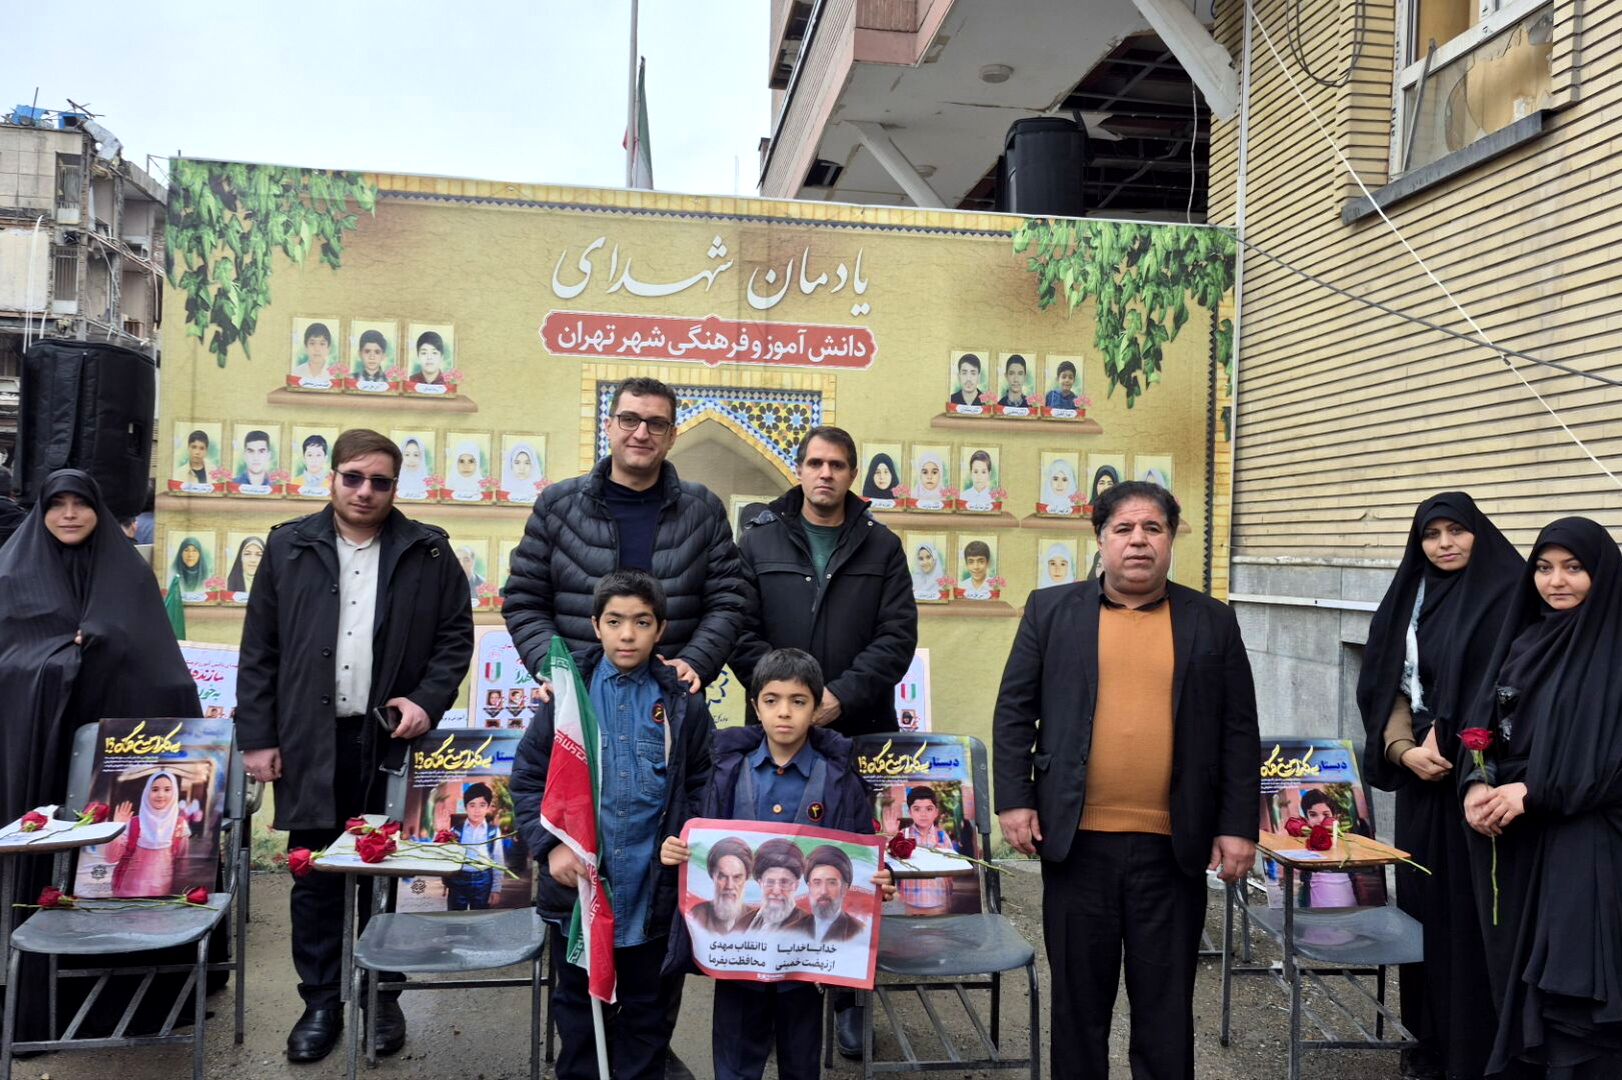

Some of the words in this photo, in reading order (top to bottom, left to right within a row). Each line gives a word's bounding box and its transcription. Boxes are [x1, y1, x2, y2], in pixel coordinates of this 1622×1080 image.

[550, 234, 736, 299] شهدای
[746, 245, 872, 318] یادمان
[558, 320, 617, 349] تهران
[619, 326, 666, 356] شهر
[667, 324, 750, 358] فرهنگی
[752, 339, 763, 359] و
[766, 328, 807, 361] آموز
[808, 332, 867, 363] دانش
[709, 940, 733, 953] مهدی
[735, 940, 760, 952] انقلاب
[761, 943, 768, 952] تا
[777, 943, 805, 955] خدایا
[806, 942, 838, 955] خدایا
[729, 955, 767, 969] محافظت
[775, 956, 802, 972] خمینی
[826, 960, 836, 972] از
